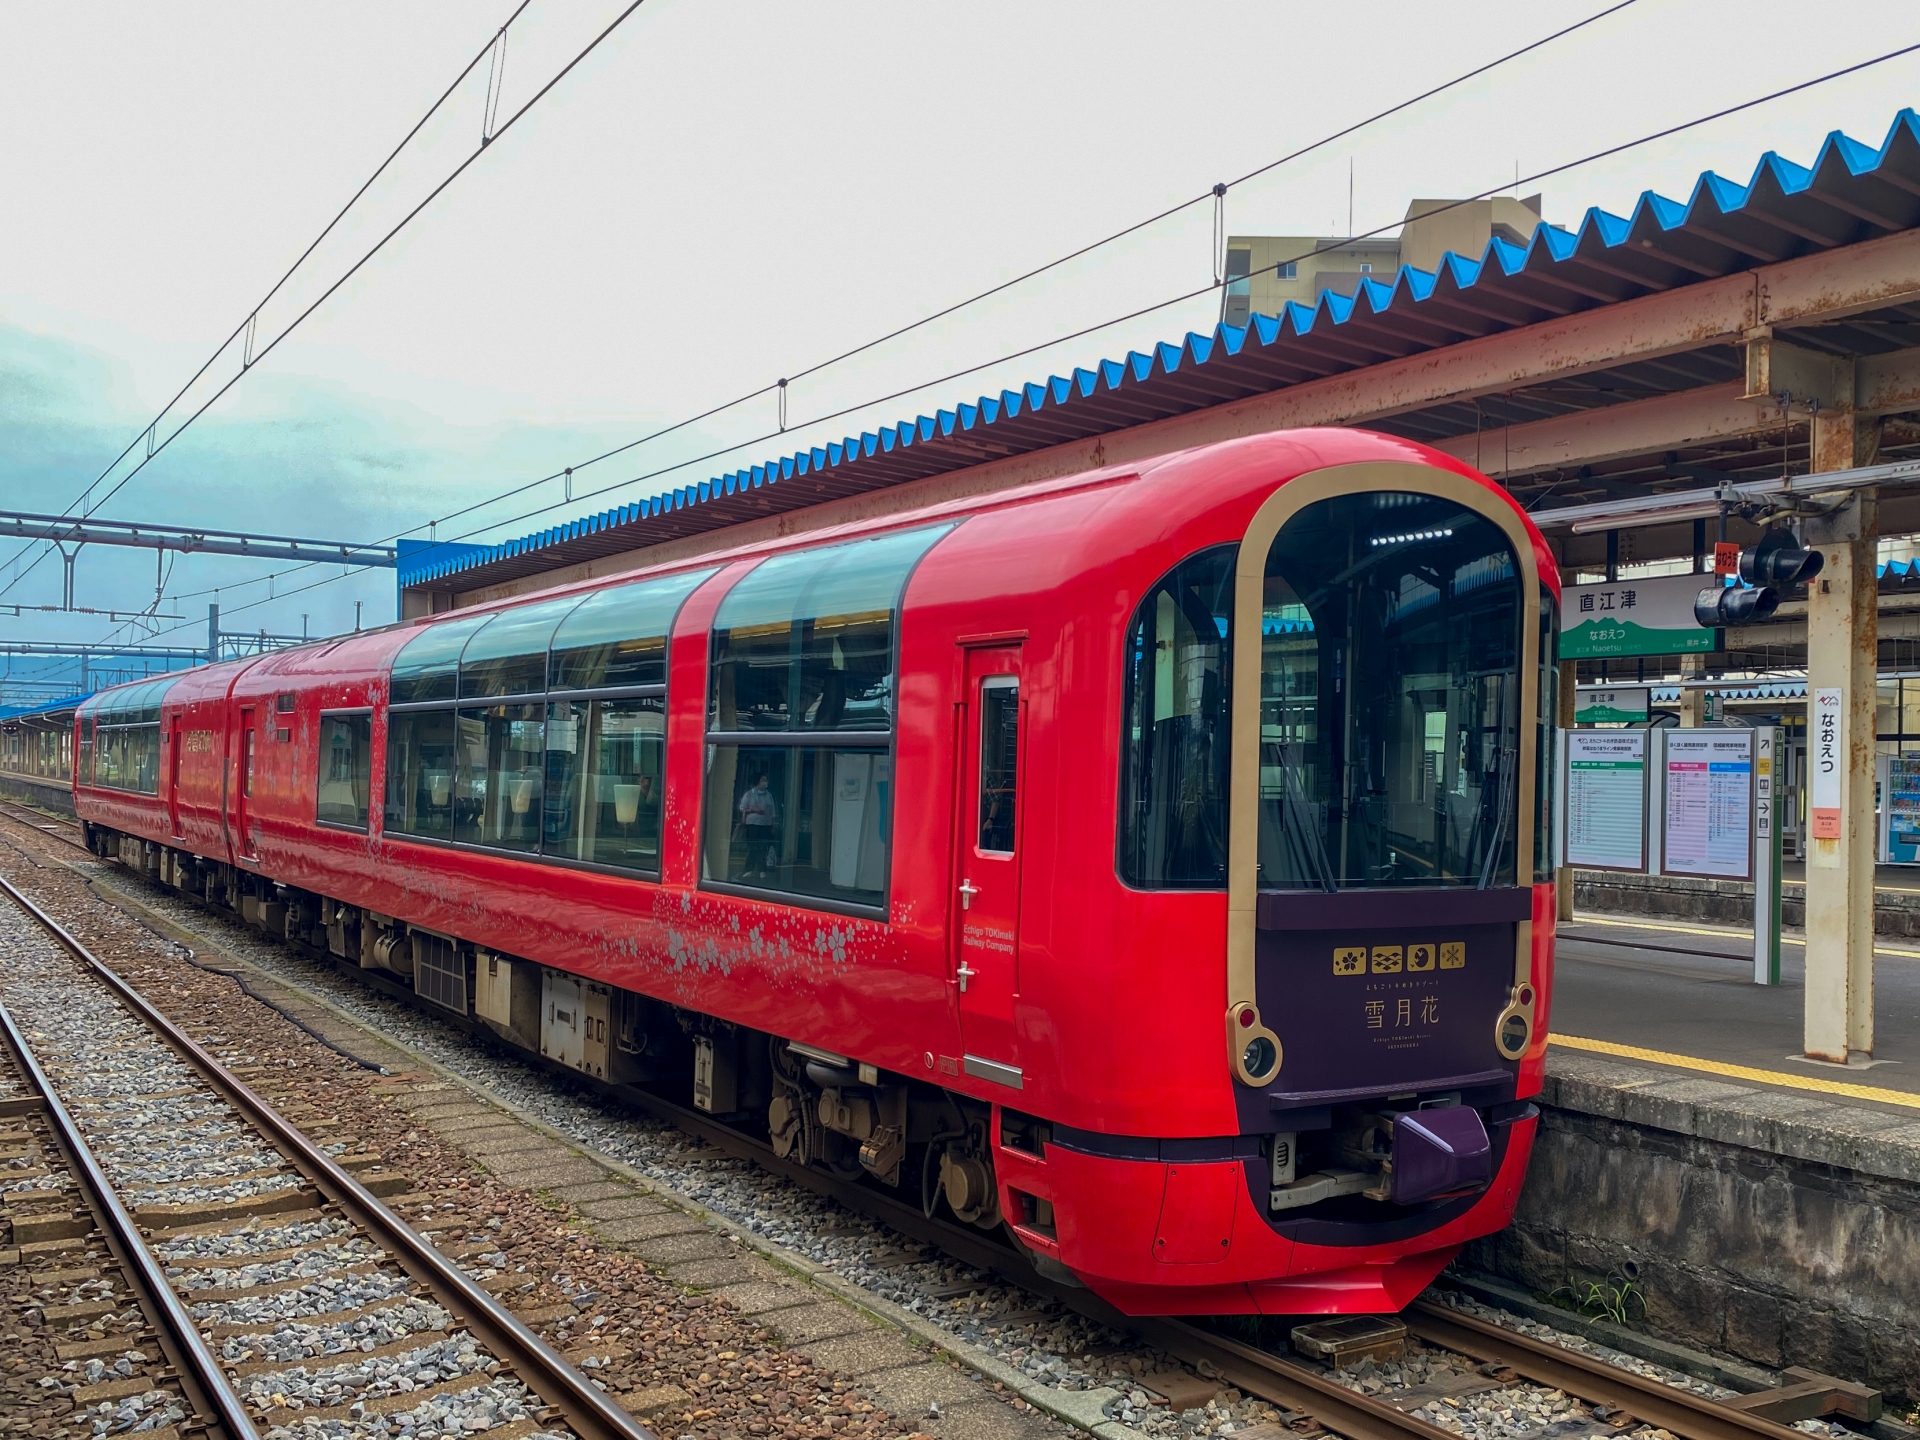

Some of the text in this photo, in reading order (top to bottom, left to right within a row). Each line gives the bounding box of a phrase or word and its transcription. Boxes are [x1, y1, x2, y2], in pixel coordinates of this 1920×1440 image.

[1716, 550, 1738, 568] はねうま
[1580, 590, 1637, 613] 直江津
[1589, 628, 1626, 641] なおえつ
[1592, 644, 1622, 653] Naoetsu
[1589, 693, 1615, 703] 直江津
[1704, 702, 1710, 714] 2
[1821, 713, 1835, 773] なおえつ
[963, 924, 1015, 941] Echigo TOKImeki
[963, 935, 1015, 955] Railway Company
[1366, 980, 1439, 991] えちごトキめきリゾート
[1365, 995, 1439, 1028] 雪月花
